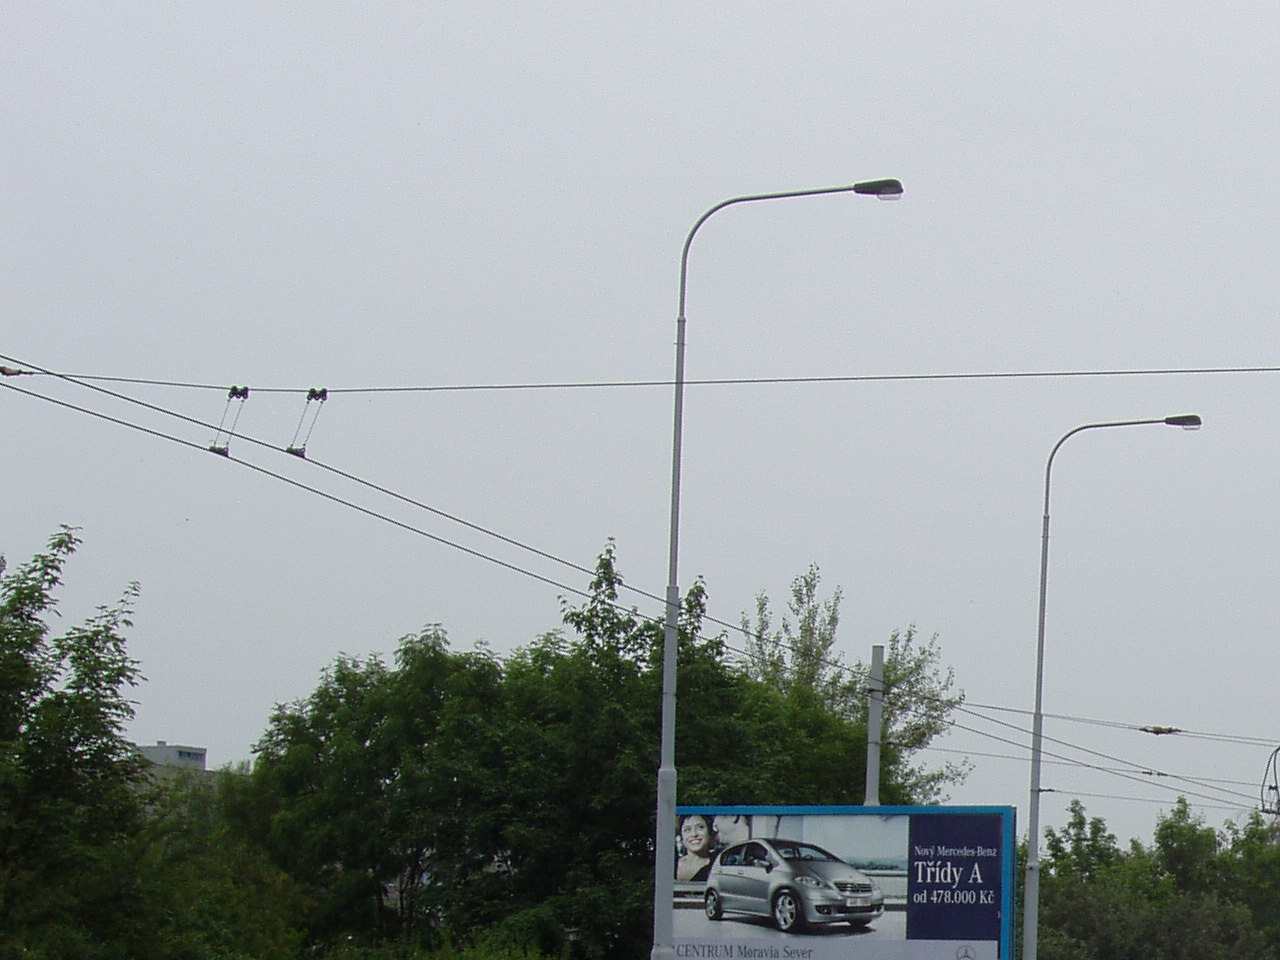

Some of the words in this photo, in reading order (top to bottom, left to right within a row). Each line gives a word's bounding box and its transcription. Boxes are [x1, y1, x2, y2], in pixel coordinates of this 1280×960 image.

[914, 846, 935, 858] Nový
[937, 846, 998, 857] Mercedes-Benz
[914, 861, 963, 889] Třídy
[968, 862, 983, 883] A
[913, 890, 927, 904] od
[930, 890, 976, 904] 478.000
[979, 890, 995, 904] Kč
[676, 944, 733, 958] CENTRUM
[737, 945, 779, 959] Moravia
[783, 946, 814, 959] Sever
